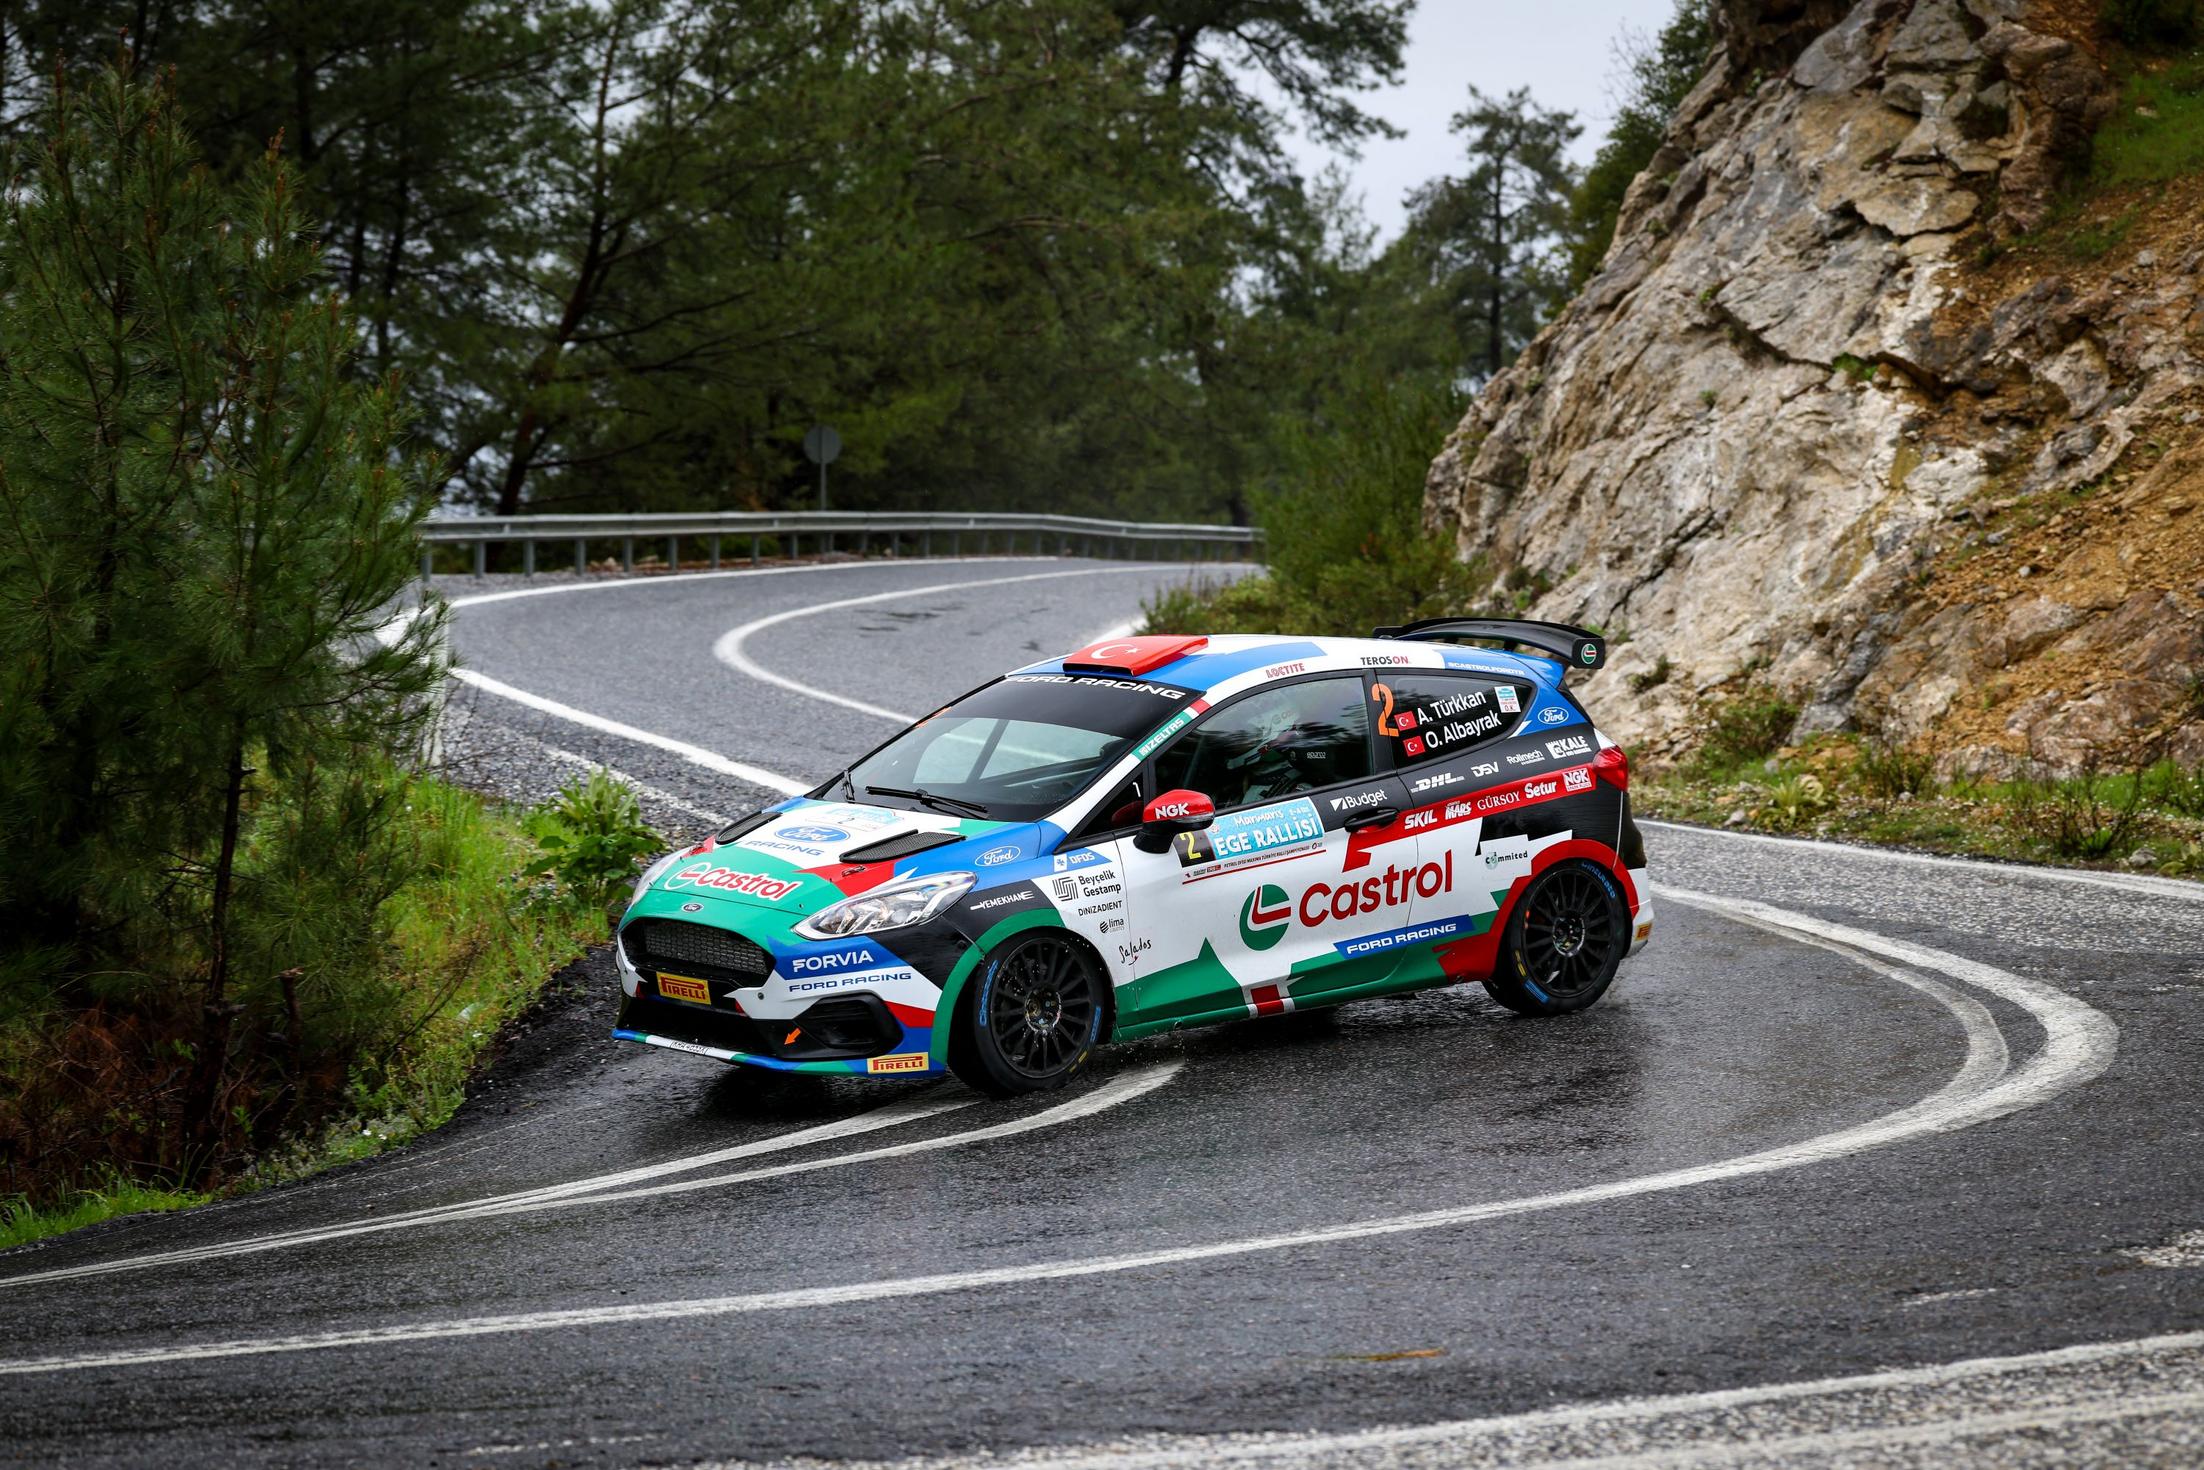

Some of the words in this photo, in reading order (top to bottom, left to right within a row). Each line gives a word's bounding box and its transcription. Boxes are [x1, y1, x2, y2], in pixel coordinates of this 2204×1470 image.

[1360, 656, 1409, 666] TEROSON
[1266, 663, 1305, 678] LOCTITE
[1001, 675, 1070, 684] FORD
[1078, 677, 1187, 700] RACING
[1371, 683, 1399, 737] 2
[1417, 707, 1433, 725] A.
[1430, 691, 1487, 719] Türkkan
[1425, 731, 1443, 749] O.
[1444, 710, 1502, 744] Albayrak
[1560, 735, 1588, 751] KALE
[1506, 749, 1544, 765] Rollmech
[1470, 761, 1499, 778] DSV
[1564, 768, 1589, 786] NGK
[1415, 773, 1457, 791] DHL
[1524, 781, 1557, 799] Setur
[1344, 789, 1388, 808] Budget
[1477, 791, 1520, 811] GÜRSOY
[1155, 802, 1190, 820] NGK
[1404, 809, 1438, 830] SKIL
[782, 826, 839, 842] Ford
[744, 840, 825, 857] RACING
[1179, 831, 1202, 860] 2
[1213, 834, 1252, 857] EGE
[983, 848, 1013, 865] Ford
[1068, 852, 1095, 864] DFDS
[700, 868, 801, 901] Castrol
[1078, 869, 1116, 886] Beyçelik
[1083, 883, 1121, 897] Gestamp
[1299, 849, 1453, 928] Castrol
[979, 889, 1035, 910] YEMEKHANE
[1109, 918, 1124, 928] lima
[1347, 936, 1393, 955] FORD
[1395, 923, 1457, 943] RACING
[792, 950, 874, 973] FORVIA
[661, 976, 706, 1001] PIRELLI
[789, 980, 837, 992] FORD
[841, 972, 912, 986] RACING
[873, 1055, 924, 1071] PIRELLI
